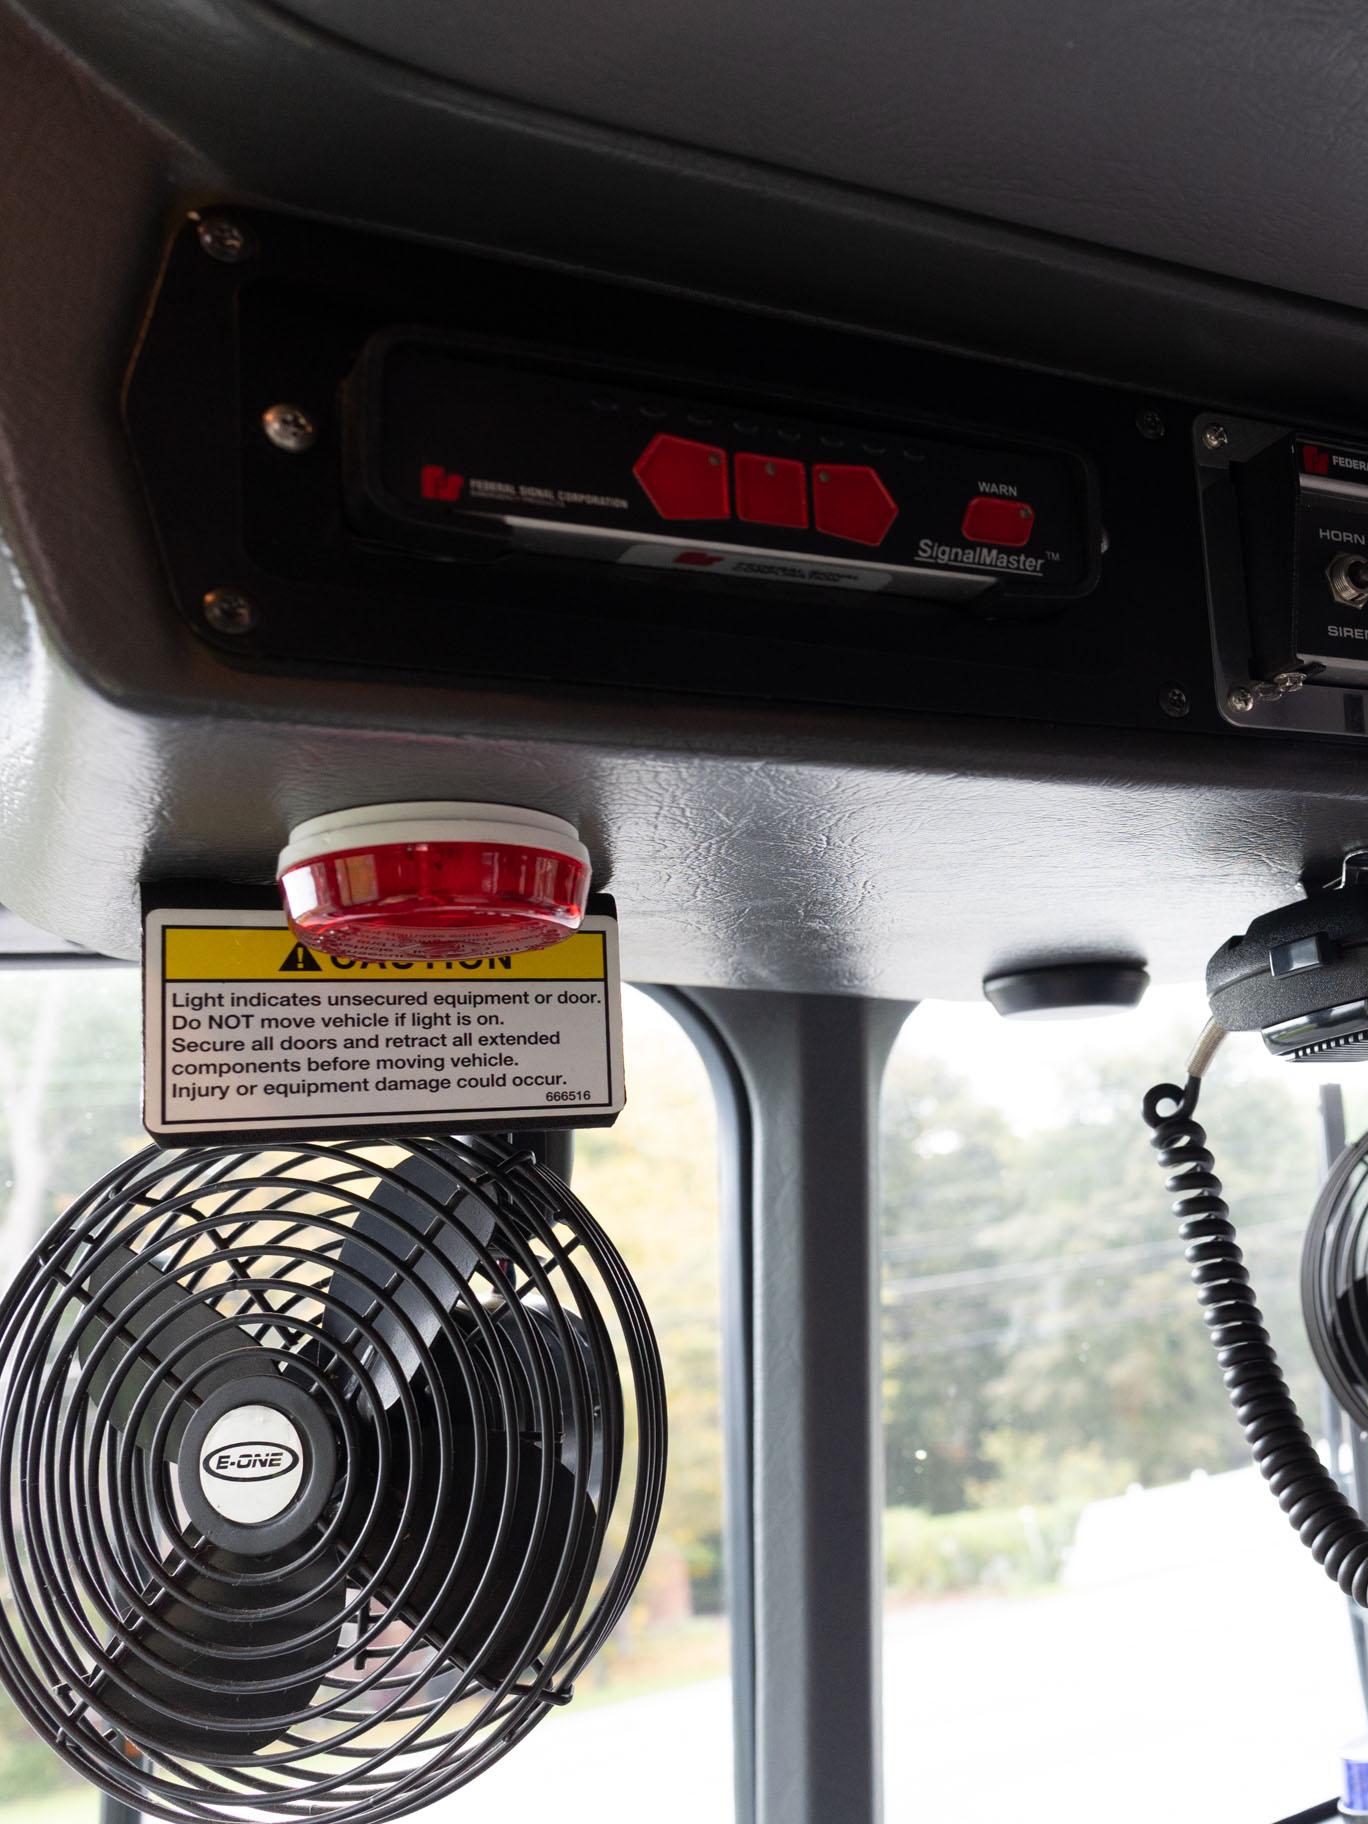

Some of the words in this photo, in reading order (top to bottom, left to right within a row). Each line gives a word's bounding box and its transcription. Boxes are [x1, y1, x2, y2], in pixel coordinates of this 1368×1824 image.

[978, 481, 1018, 497] WARN
[1318, 527, 1367, 546] HORN
[172, 992, 225, 1011] Light
[230, 992, 322, 1007] indicates
[327, 991, 427, 1006] unsecured
[433, 991, 530, 1008] equipment
[534, 993, 553, 1005] or
[557, 990, 602, 1004] door.
[172, 1015, 201, 1030] Do
[208, 1014, 254, 1030] NOT
[260, 1016, 316, 1029] move
[321, 1013, 389, 1028] vehicle
[395, 1013, 406, 1027] if
[411, 1012, 451, 1030] light
[456, 1012, 472, 1026] is
[477, 1014, 505, 1026] on.
[171, 1037, 245, 1053] Secure
[251, 1036, 274, 1051] all
[280, 1035, 338, 1051] doors
[343, 1034, 379, 1049] and
[385, 1034, 447, 1048] retract
[452, 1032, 473, 1047] all
[478, 1031, 561, 1046] extended
[171, 1058, 301, 1078] components
[307, 1057, 370, 1073] before
[376, 1054, 445, 1072] moving
[450, 1052, 519, 1068] vehicle.
[172, 1081, 230, 1101] Injury
[236, 1083, 258, 1096] or
[263, 1078, 370, 1098] equipment
[375, 1077, 451, 1093] damage
[456, 1073, 506, 1089] could
[512, 1074, 568, 1087] occur.
[545, 1090, 591, 1102] 666516
[216, 1452, 283, 1470] E-ONE
